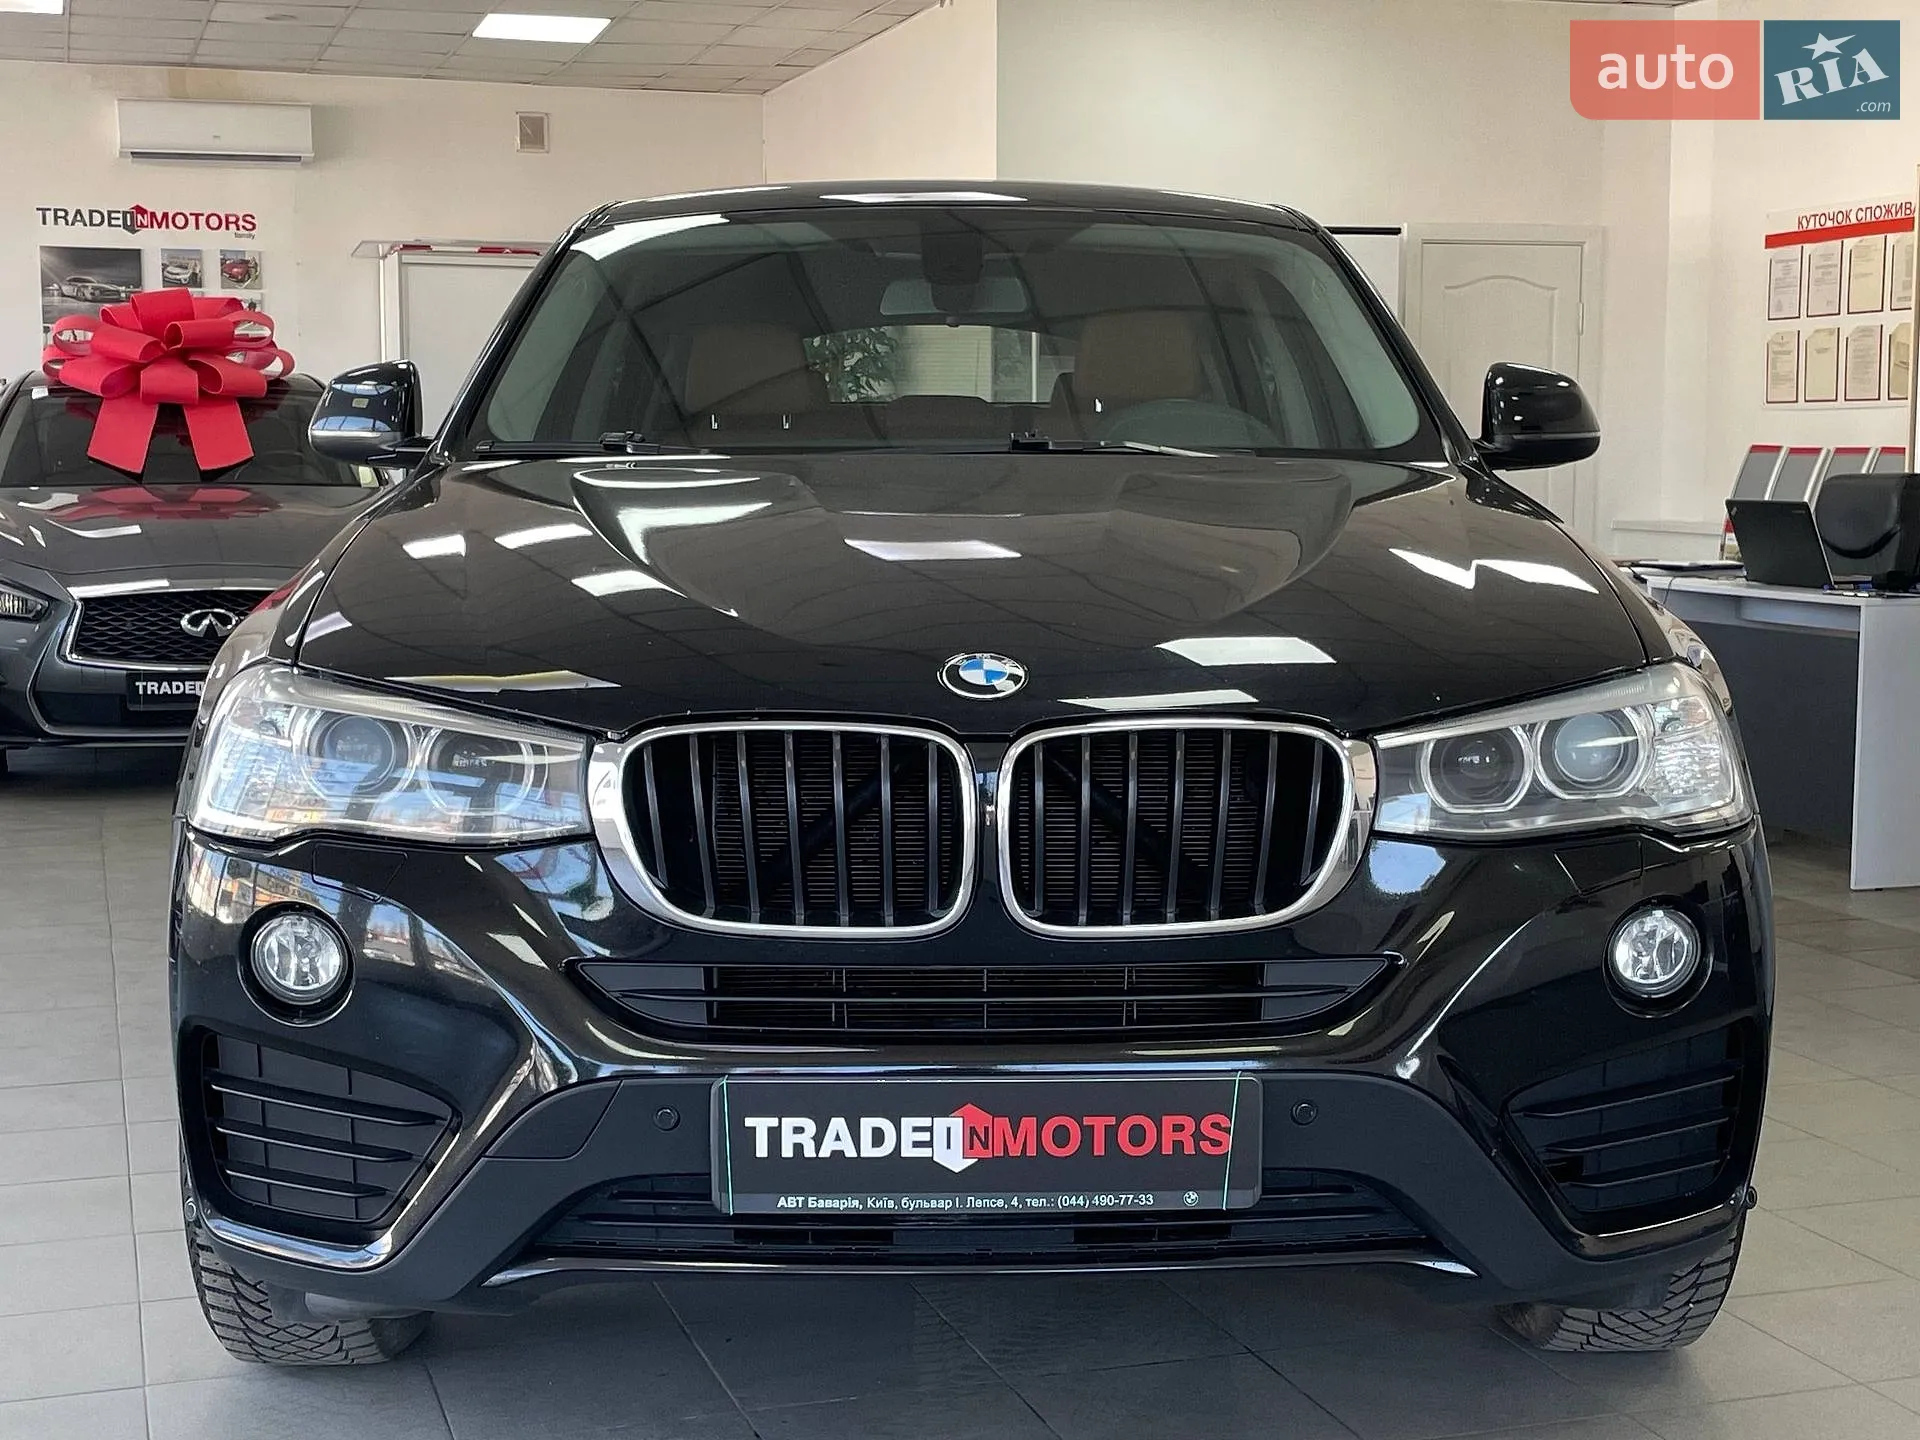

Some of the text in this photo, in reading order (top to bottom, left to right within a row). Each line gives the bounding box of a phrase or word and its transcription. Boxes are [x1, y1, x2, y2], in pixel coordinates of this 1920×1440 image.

[1797, 209, 1853, 231] КУТОЧОК
[776, 1196, 805, 1208] АВТ
[867, 1196, 898, 1211] Київ,
[901, 1196, 953, 1211] бульвар
[1057, 1195, 1090, 1209] (044)
[1092, 1194, 1154, 1206] 490-77-33
